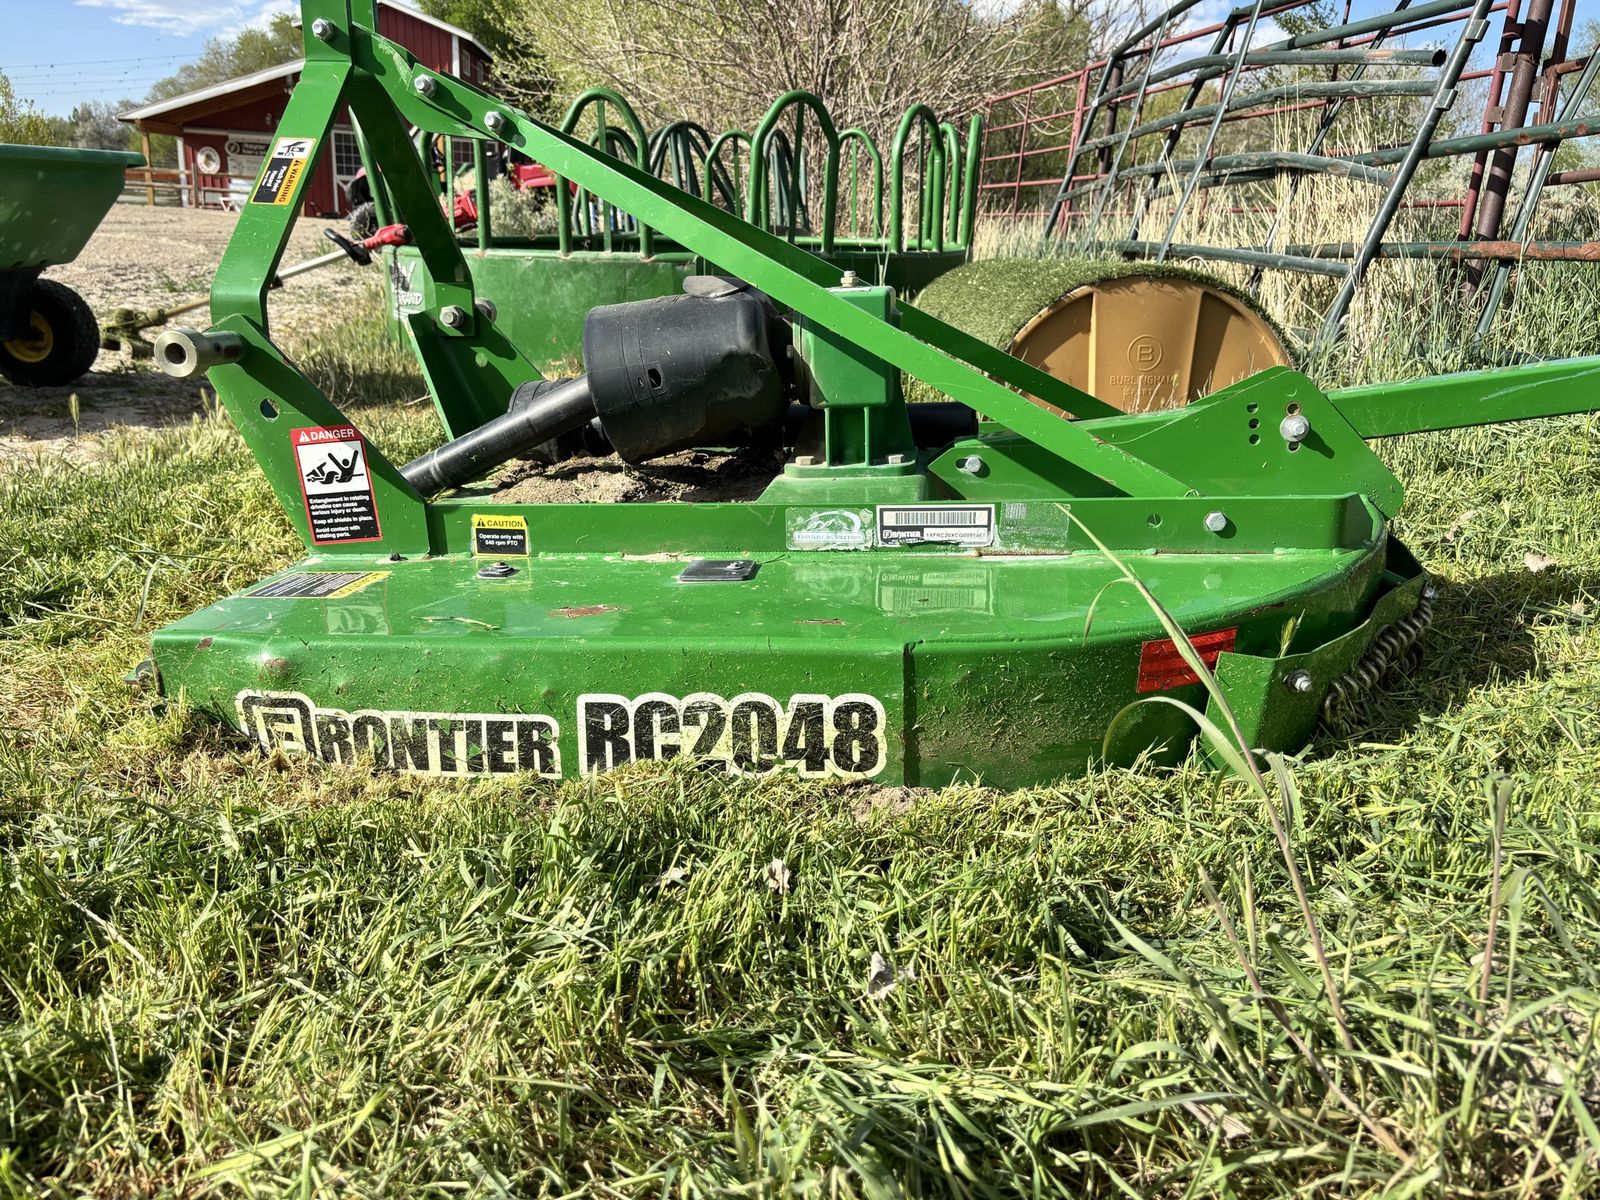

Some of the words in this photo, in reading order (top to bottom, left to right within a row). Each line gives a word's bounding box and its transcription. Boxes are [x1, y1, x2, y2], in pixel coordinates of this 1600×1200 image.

[271, 180, 282, 192] Point
[278, 167, 299, 203] WARNING
[1109, 375, 1175, 385] BURLNGHAM
[310, 428, 355, 441] DANGER
[239, 692, 559, 775] FRONTIER
[580, 696, 883, 774] RC2048
